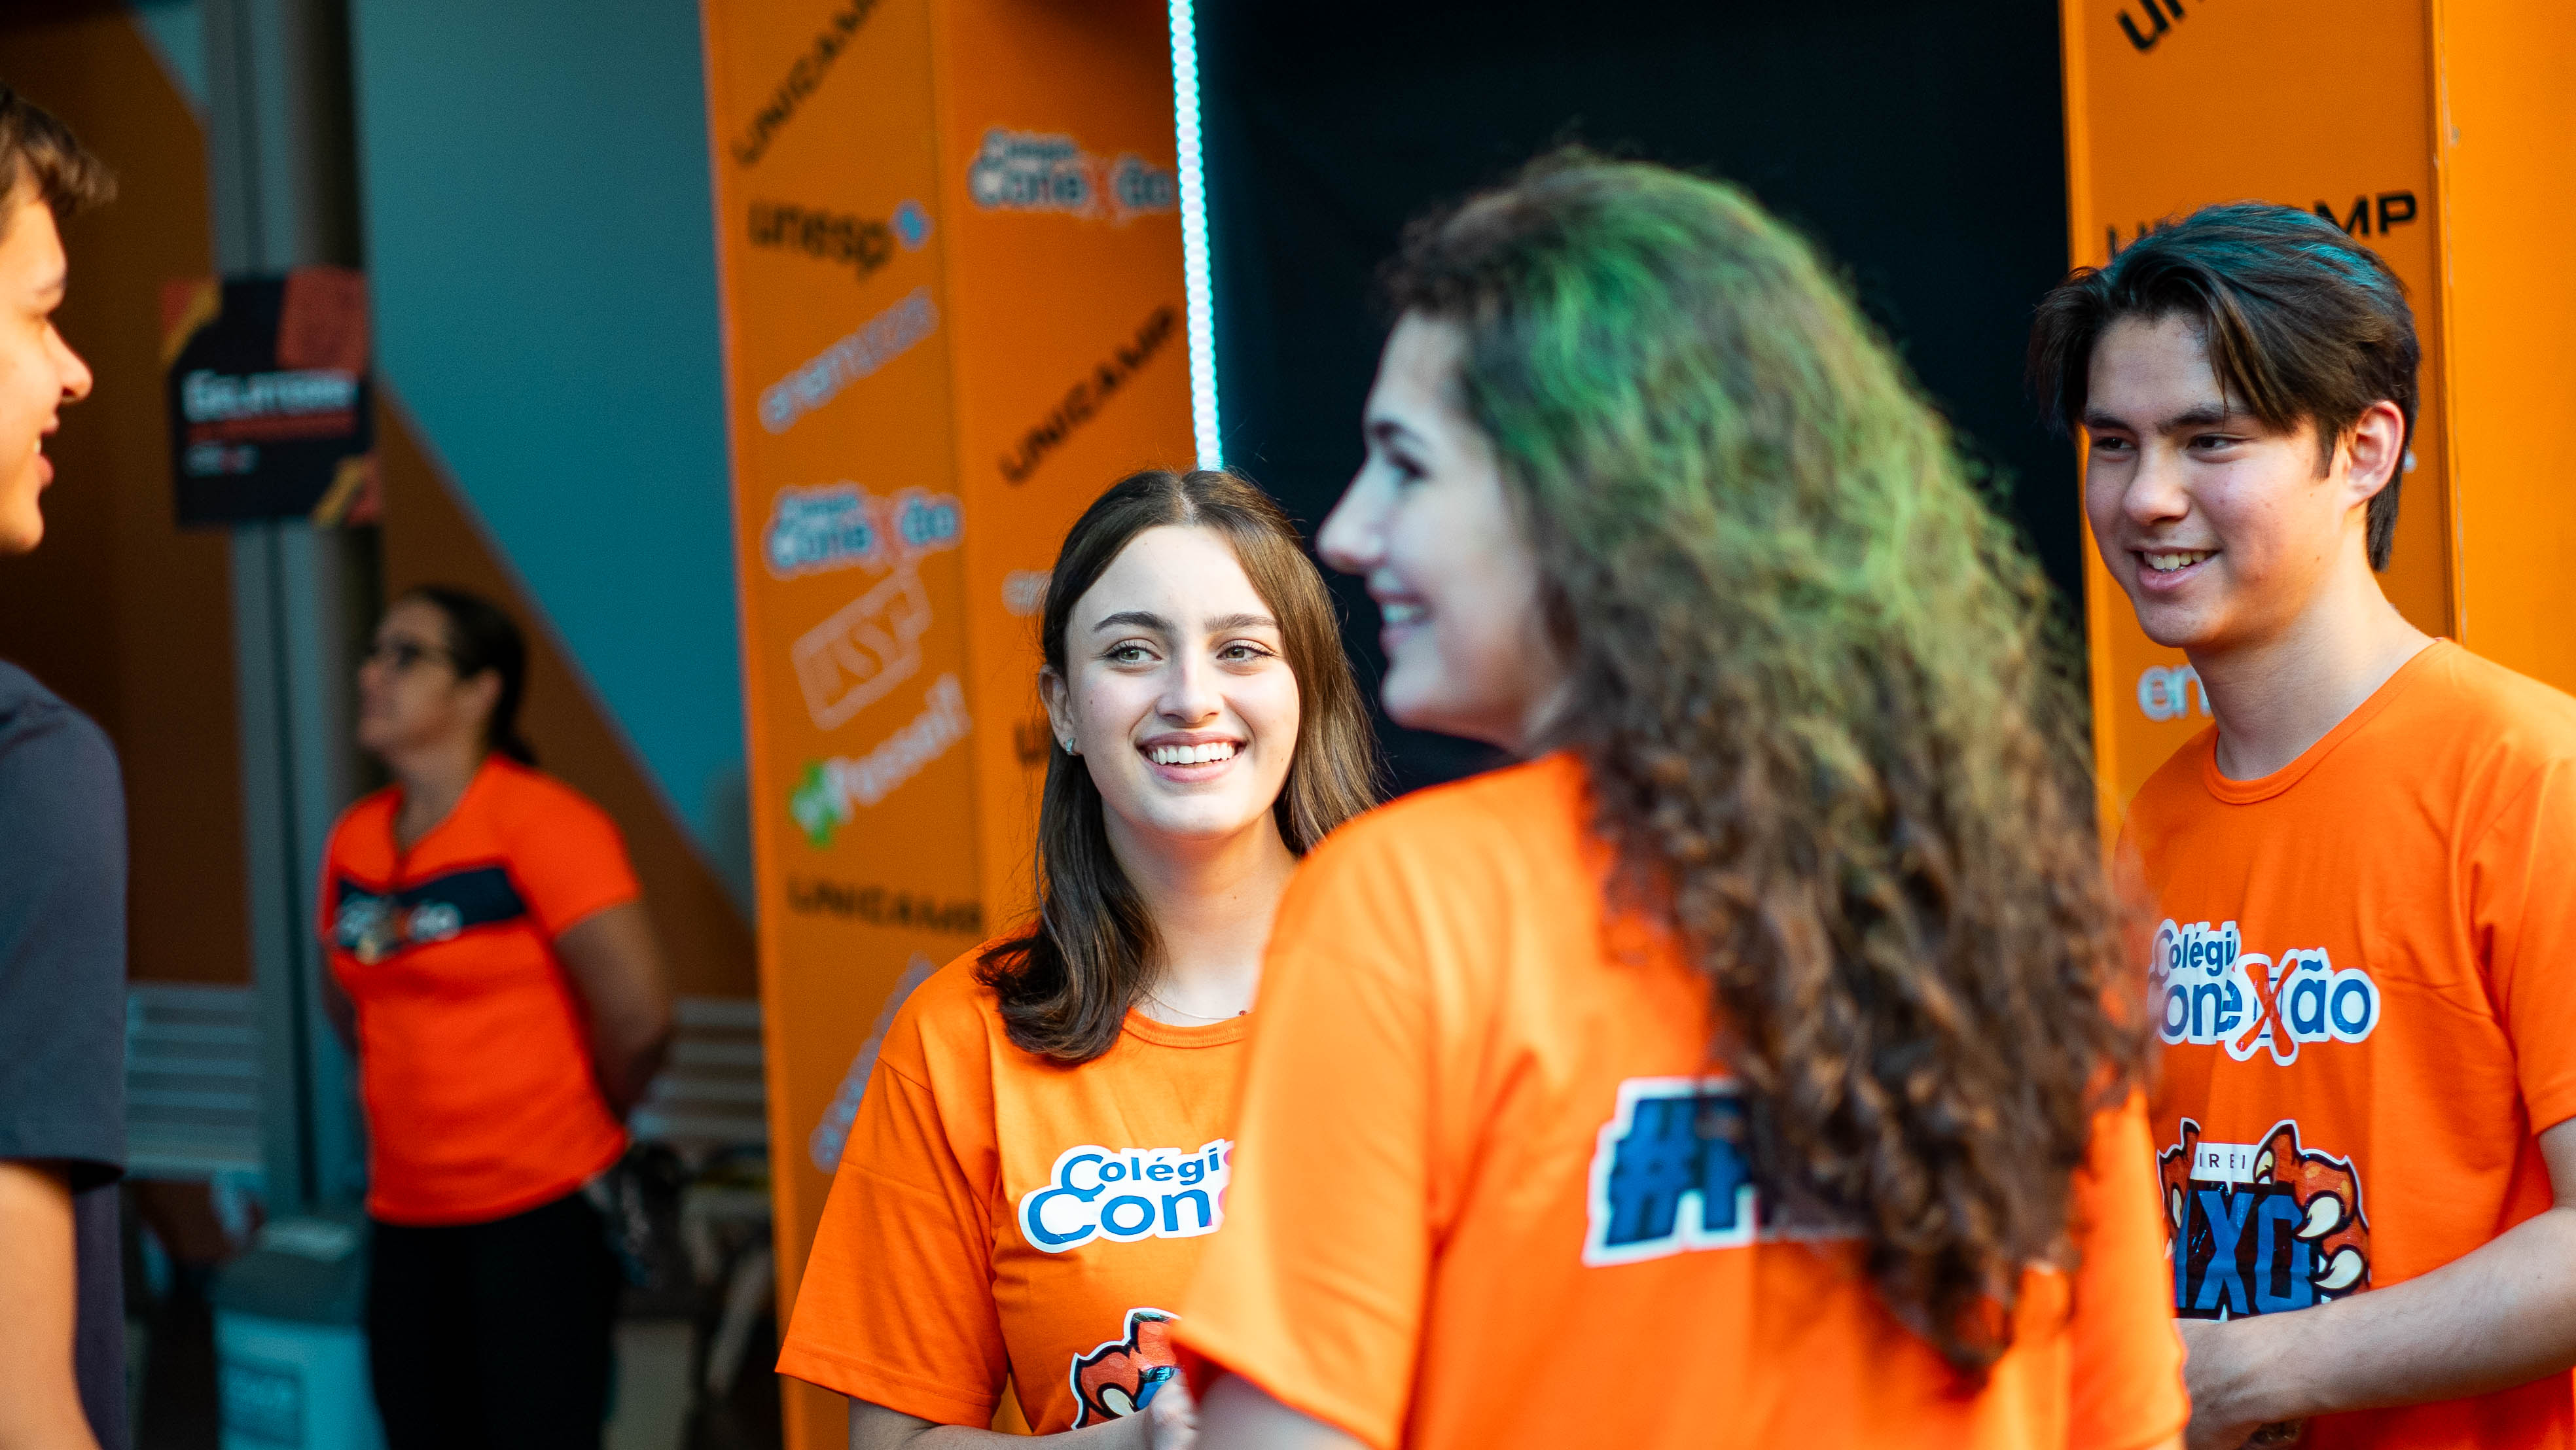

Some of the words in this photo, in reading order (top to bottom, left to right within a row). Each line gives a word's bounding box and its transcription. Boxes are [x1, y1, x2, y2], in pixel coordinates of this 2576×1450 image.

[729, 0, 884, 167] UNICAM
[747, 200, 894, 283] unesp
[998, 305, 1177, 484] UNICAMP
